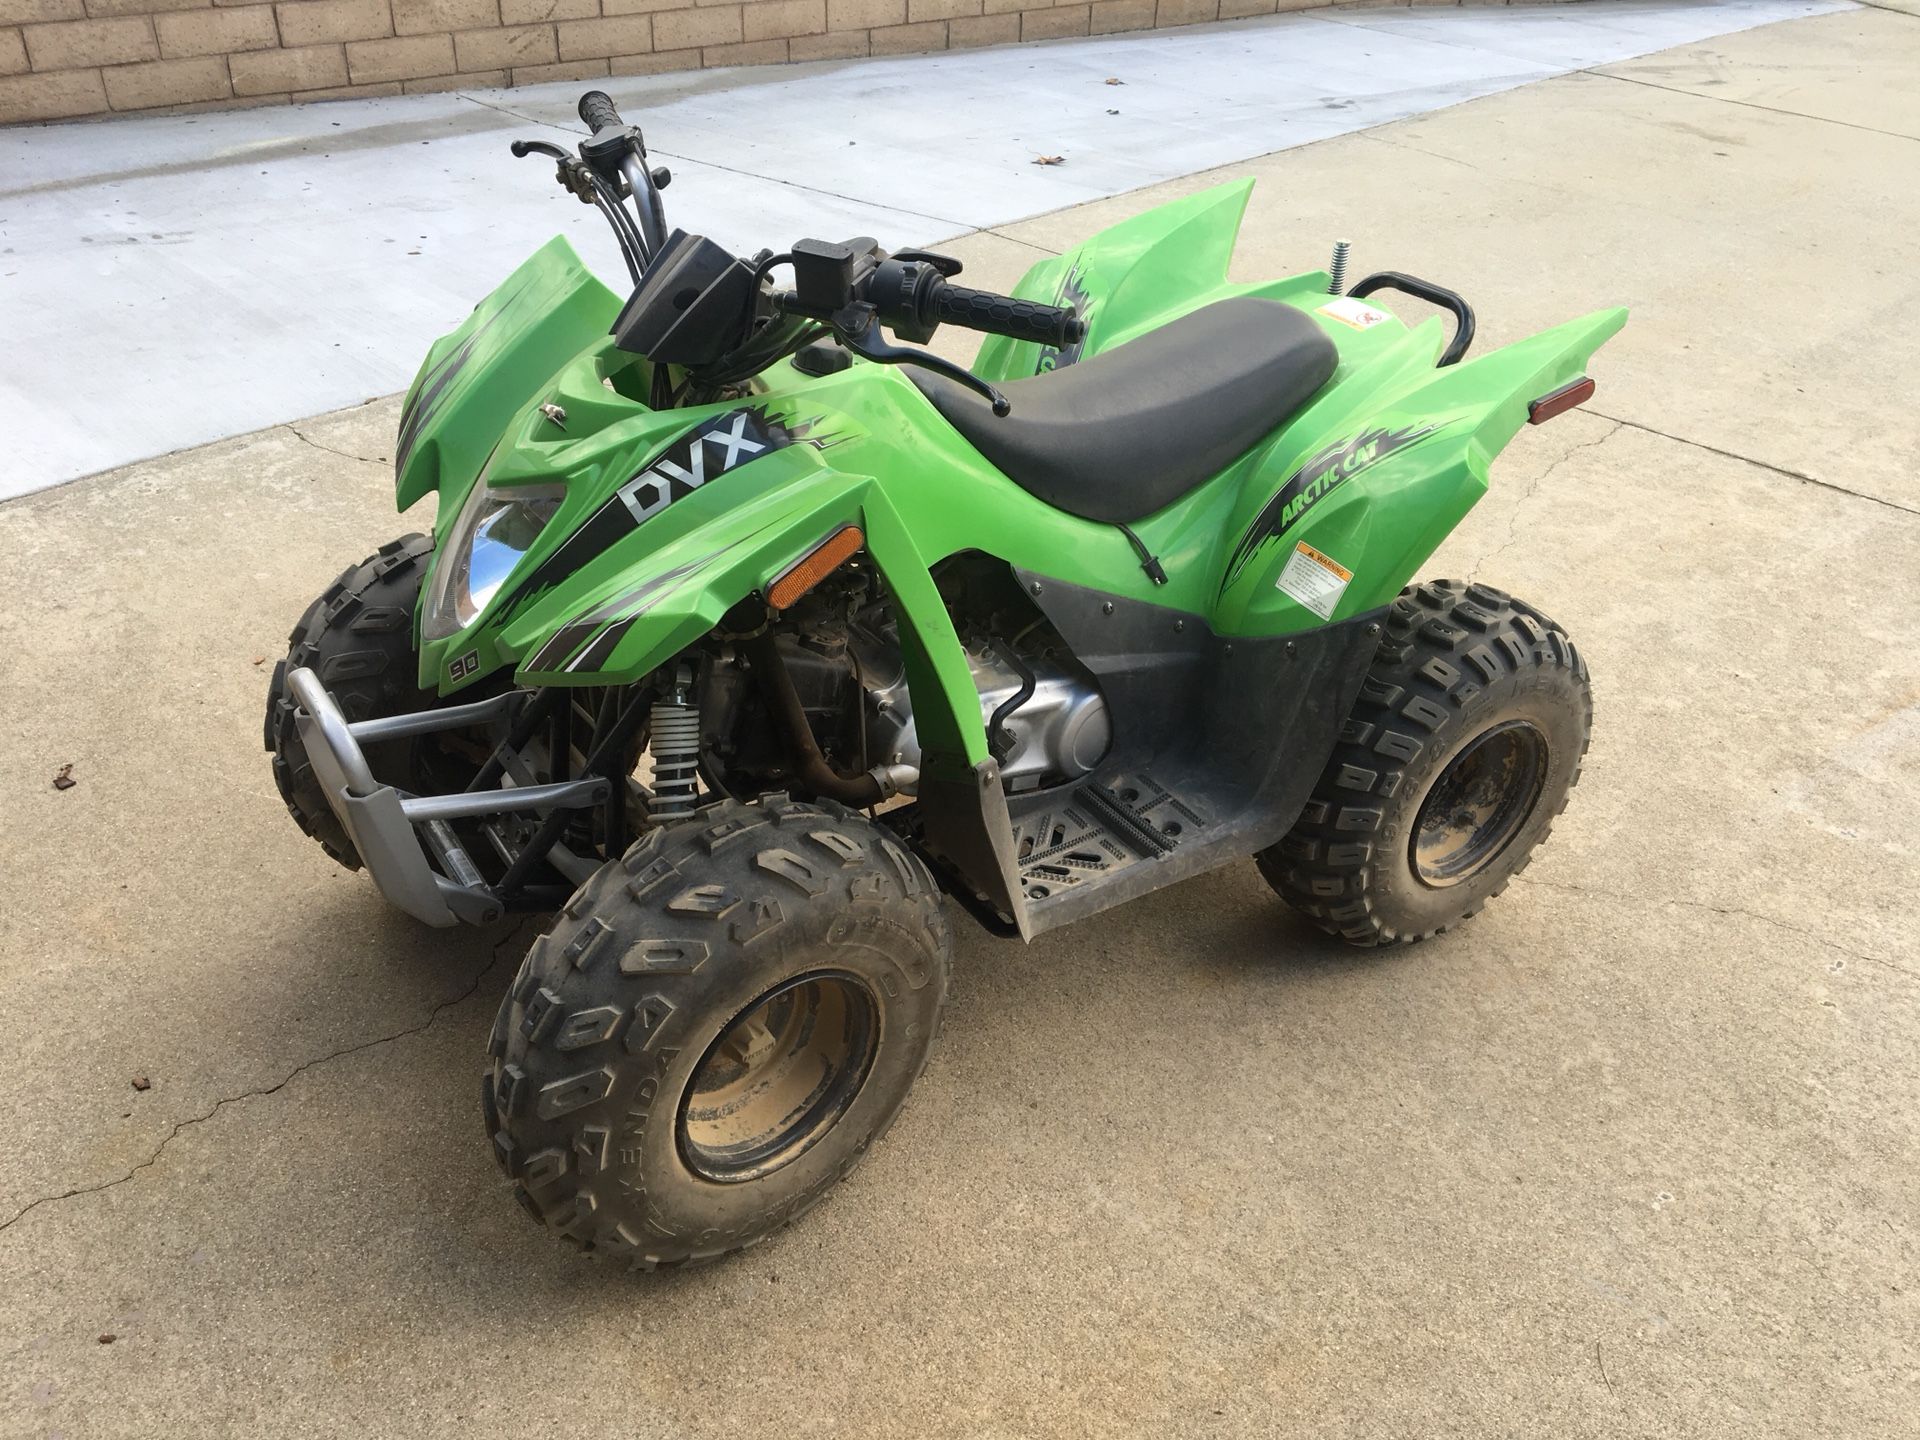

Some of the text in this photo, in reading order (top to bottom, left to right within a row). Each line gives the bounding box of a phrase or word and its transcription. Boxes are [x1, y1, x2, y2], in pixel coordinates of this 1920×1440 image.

[617, 412, 766, 525] DVX
[1281, 439, 1379, 528] ARCTIC CAT
[1316, 554, 1345, 577] WARNING
[448, 648, 481, 684] 90
